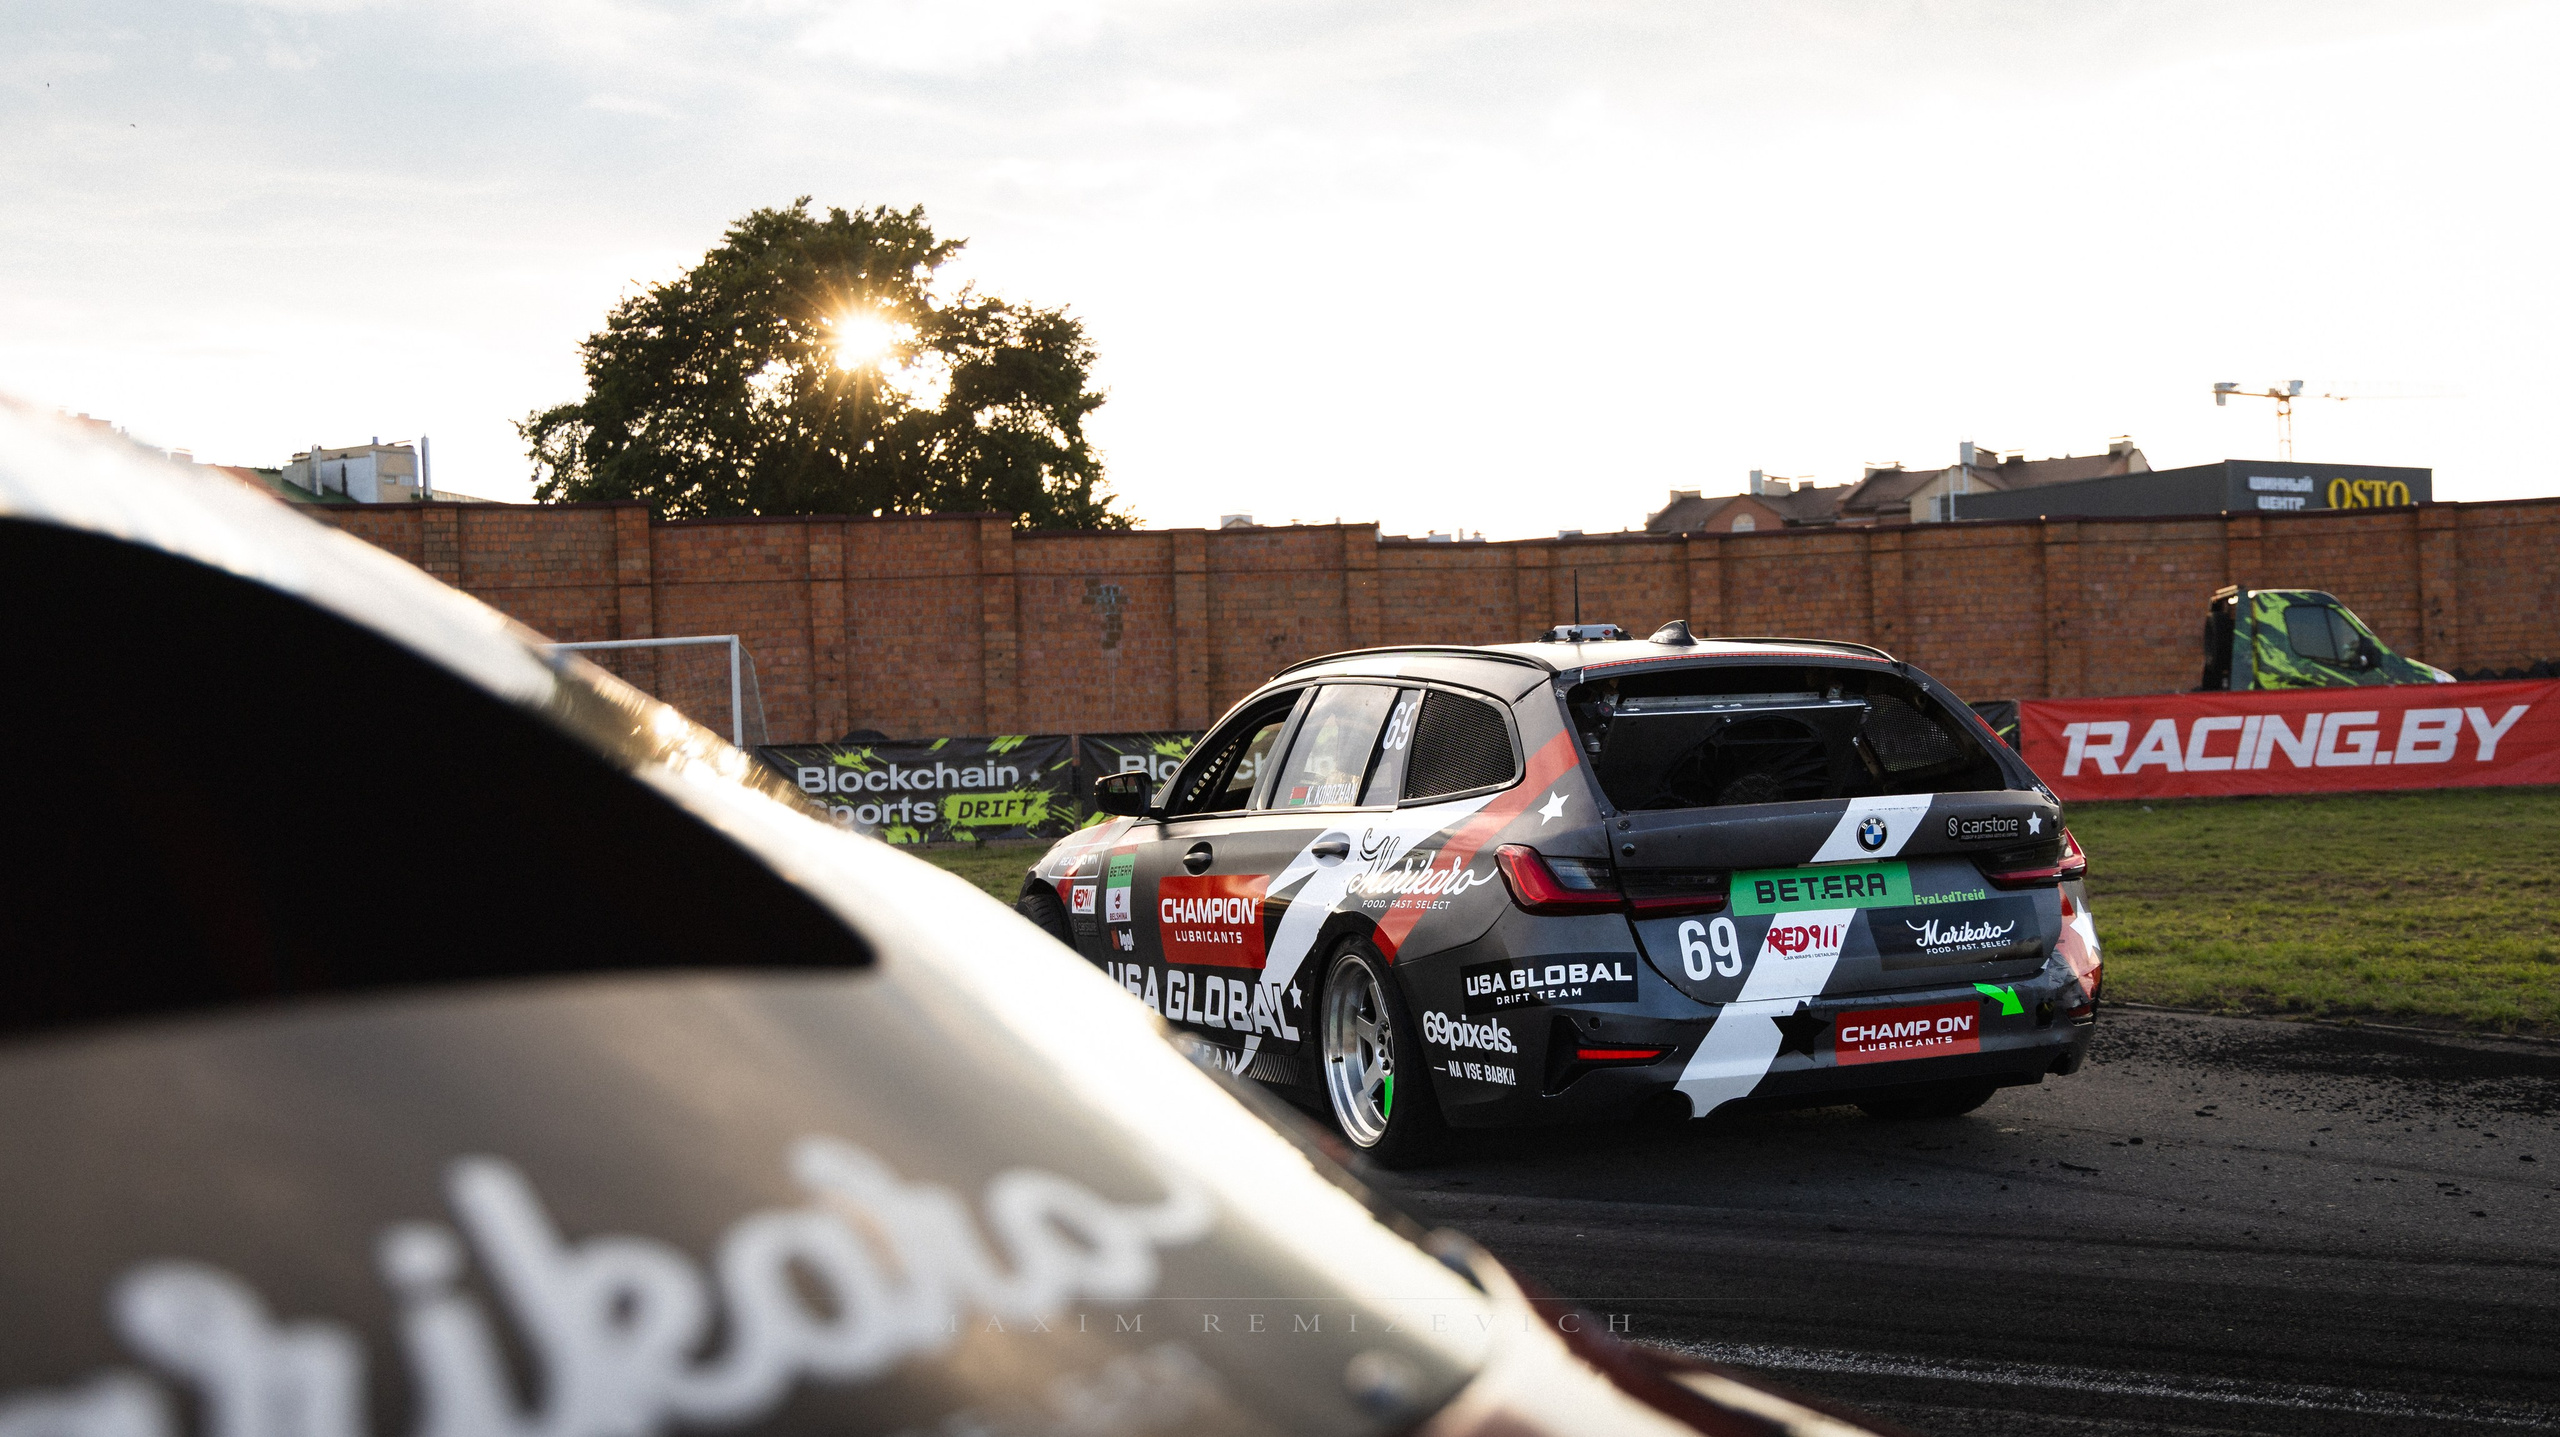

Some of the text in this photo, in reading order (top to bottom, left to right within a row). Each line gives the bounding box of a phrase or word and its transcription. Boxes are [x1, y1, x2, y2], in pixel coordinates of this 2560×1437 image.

[2328, 477, 2411, 510] OSTO
[1382, 701, 1417, 751] 69
[797, 760, 1020, 794] Blockchain
[957, 798, 1033, 820] DRIFT
[1861, 817, 1886, 830] BMW
[1961, 817, 2019, 834] carstore
[1346, 828, 1499, 896] Marikaro
[1161, 897, 1256, 925] CHAMPION
[1361, 899, 1451, 910] FOOD. FAST. SELECT
[1914, 889, 1986, 905] EvaLedTreid
[1175, 930, 1243, 944] LUBRICANTS
[1906, 919, 2015, 947] Marikaro
[1926, 939, 2012, 955] FOOD. FAST. SELECT
[1678, 917, 1743, 981] 69
[1466, 962, 1633, 996] USA GLOBAL
[1165, 969, 1301, 1042] GLOBAL
[1496, 987, 1582, 1006] DRIFT TEAM
[1423, 1010, 1518, 1054] 69pixels.
[1859, 1036, 1953, 1052] LUBRICANTS
[1448, 1060, 1517, 1086] NA VSE BABKI!
[0, 1130, 1222, 1437] rikaro
